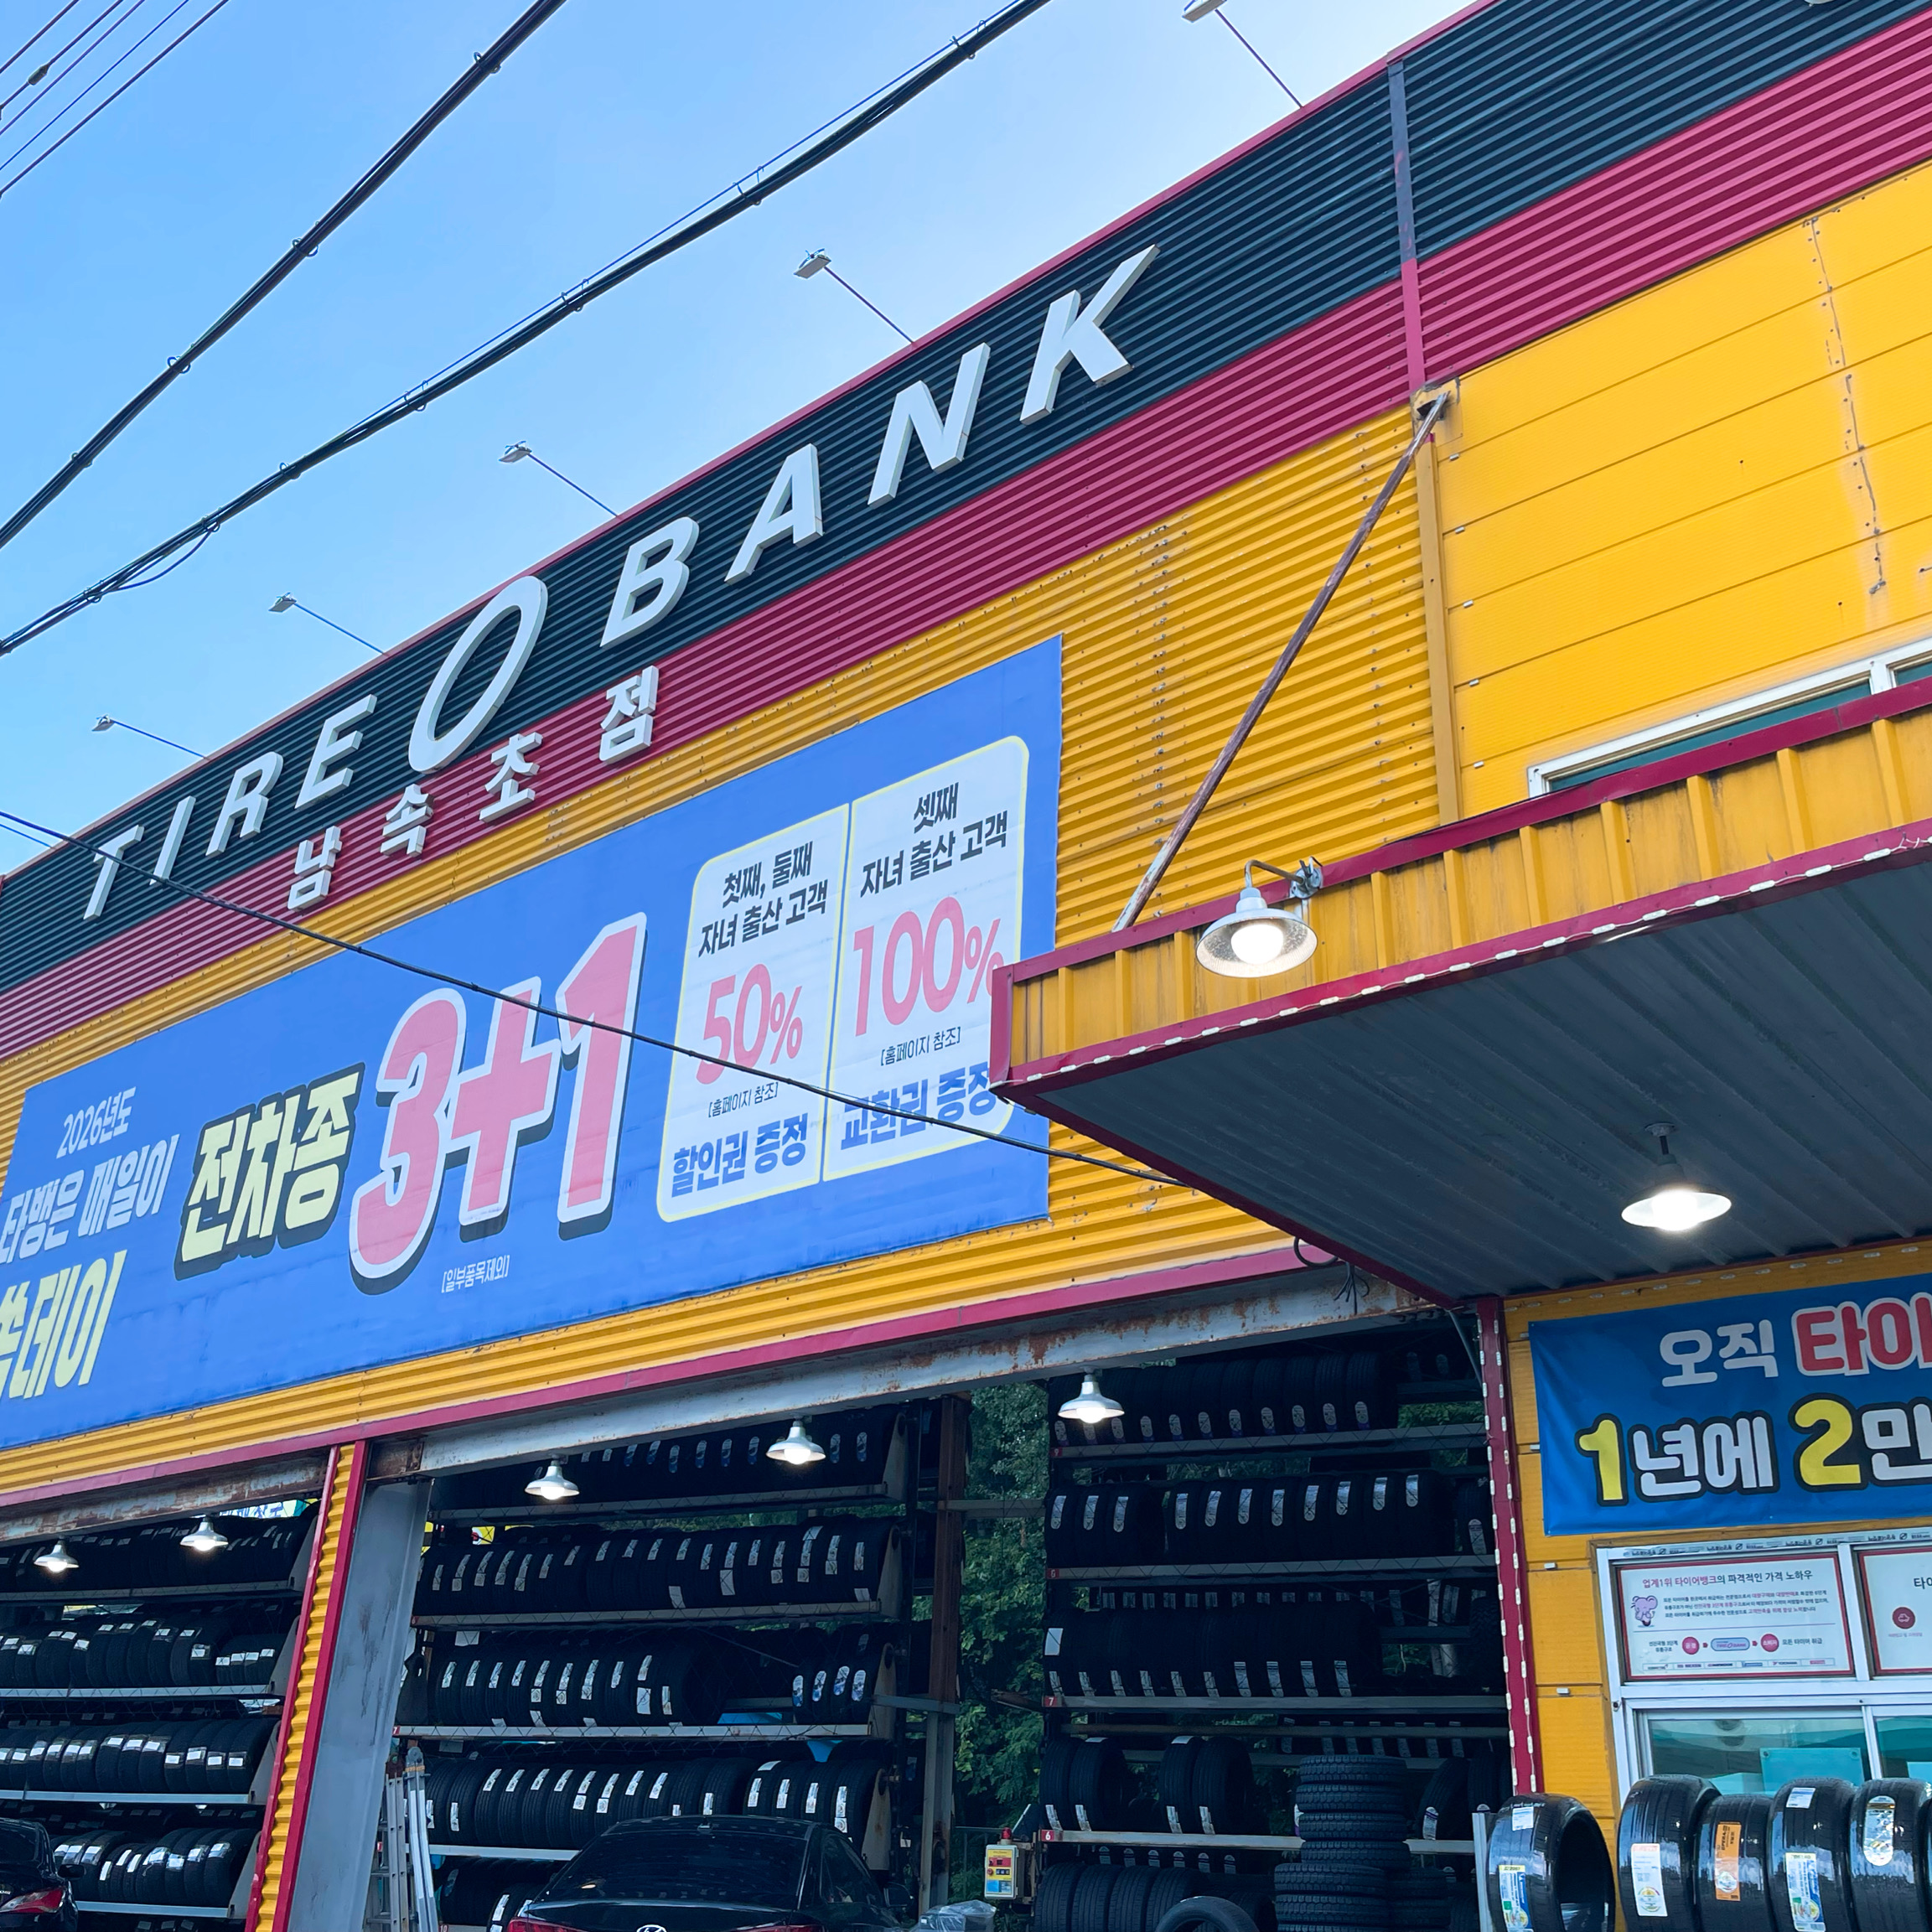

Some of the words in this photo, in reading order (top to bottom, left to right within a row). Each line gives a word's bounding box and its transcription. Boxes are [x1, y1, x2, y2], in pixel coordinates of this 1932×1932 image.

[287, 666, 660, 911] 남속초점
[914, 783, 960, 834] 셋째
[722, 865, 765, 908] 첫째,
[772, 842, 814, 888] 둘째
[861, 855, 904, 898] 자녀
[910, 838, 956, 880] 출산
[960, 811, 1007, 861] 고객
[697, 915, 737, 957] 자녀
[742, 900, 782, 943] 출산
[785, 879, 828, 921] 고객
[852, 896, 1005, 1037] 100%
[696, 963, 803, 1085] 50%
[881, 1035, 930, 1066] [홈페이지
[933, 1026, 961, 1051] 참조]
[56, 1087, 136, 1159] 2026년도
[349, 912, 648, 1281] 3+1
[708, 1088, 752, 1118] [홈페이지
[754, 1081, 778, 1105] 참조]
[841, 1079, 929, 1151] 교환권
[77, 1133, 180, 1238] 매일이
[181, 1071, 360, 1262] 전차종
[671, 1130, 748, 1197] 할인권
[754, 1112, 808, 1174] 증정
[441, 1254, 510, 1293] [일부품목제외]
[1659, 1319, 1779, 1387] 오직
[1578, 1415, 1774, 1500] 1년에
[1642, 1577, 1673, 1589] 업계1위
[1674, 1572, 1727, 1588] 타이어뱅크의
[1727, 1572, 1764, 1584] 파격적인
[1764, 1571, 1784, 1582] 가격
[1785, 1569, 1813, 1581] 노하우
[1044, 1831, 1051, 1841] 6
